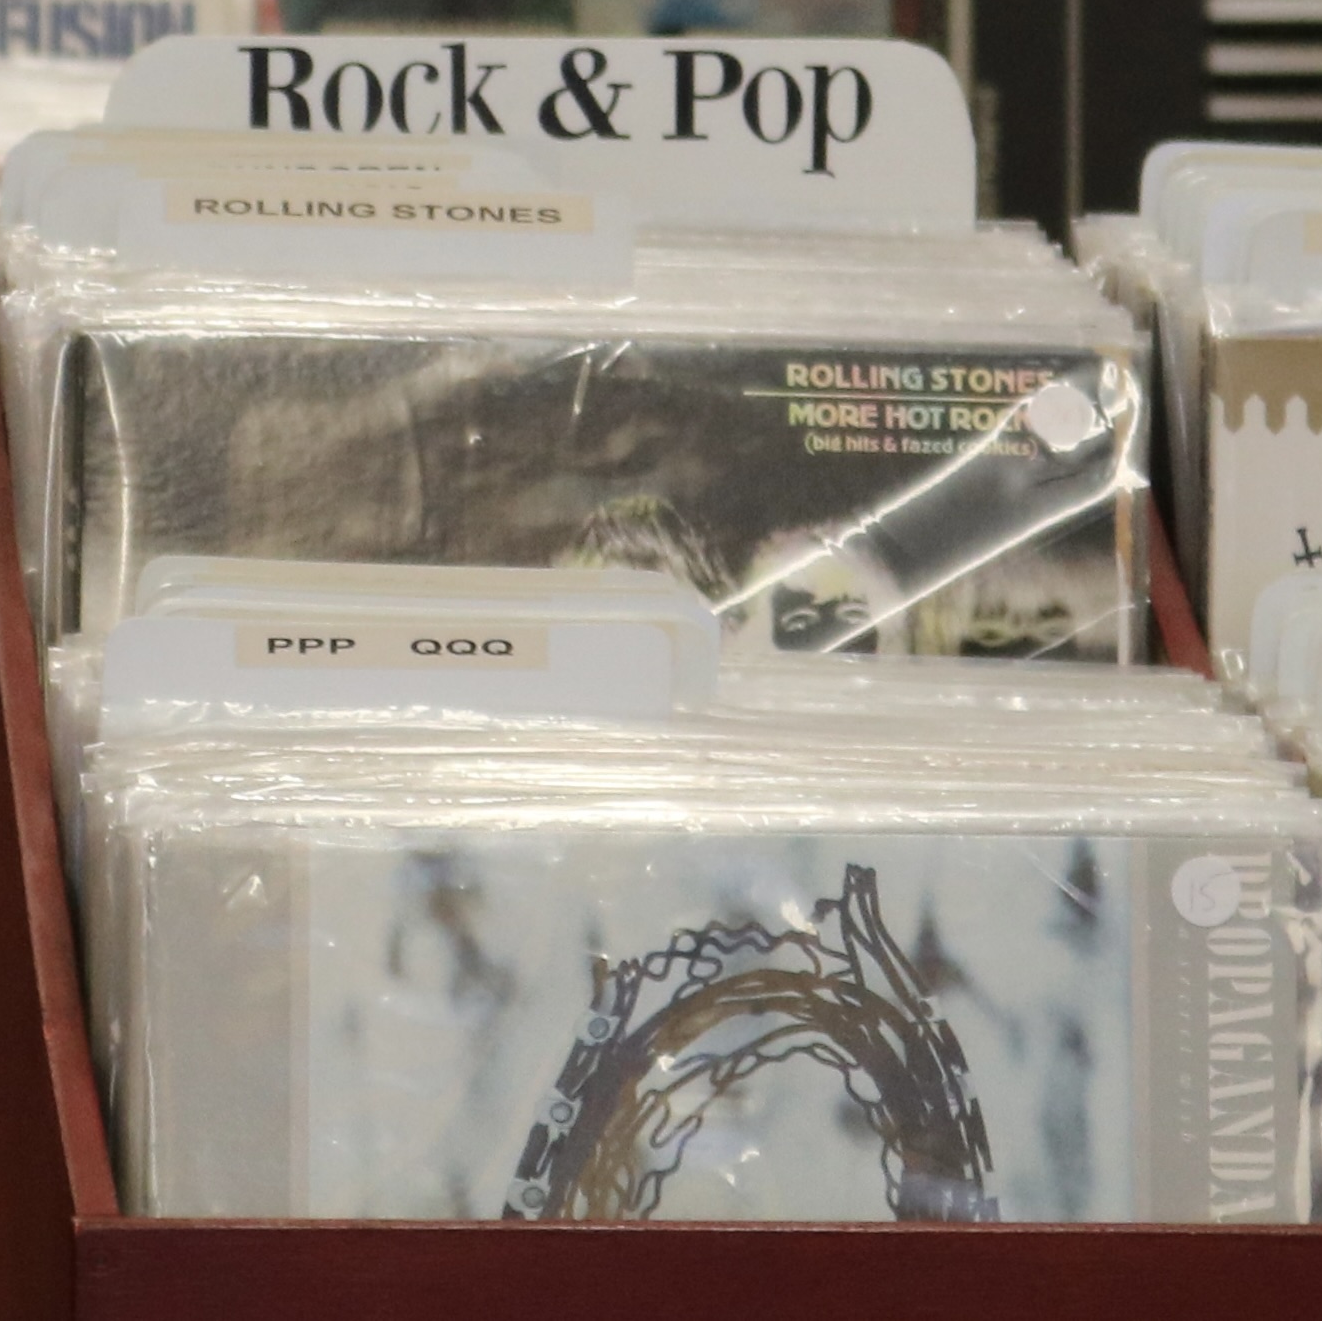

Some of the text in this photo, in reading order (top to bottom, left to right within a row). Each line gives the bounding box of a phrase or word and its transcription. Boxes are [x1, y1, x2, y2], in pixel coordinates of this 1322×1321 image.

[238, 43, 873, 178] Rock & Pop
[194, 198, 562, 224] ROLLING STONES
[785, 362, 925, 391] ROLLING
[787, 402, 878, 429] MORE
[885, 405, 945, 431] HOT
[883, 436, 897, 453] &
[267, 637, 515, 657] PPP QQQ
